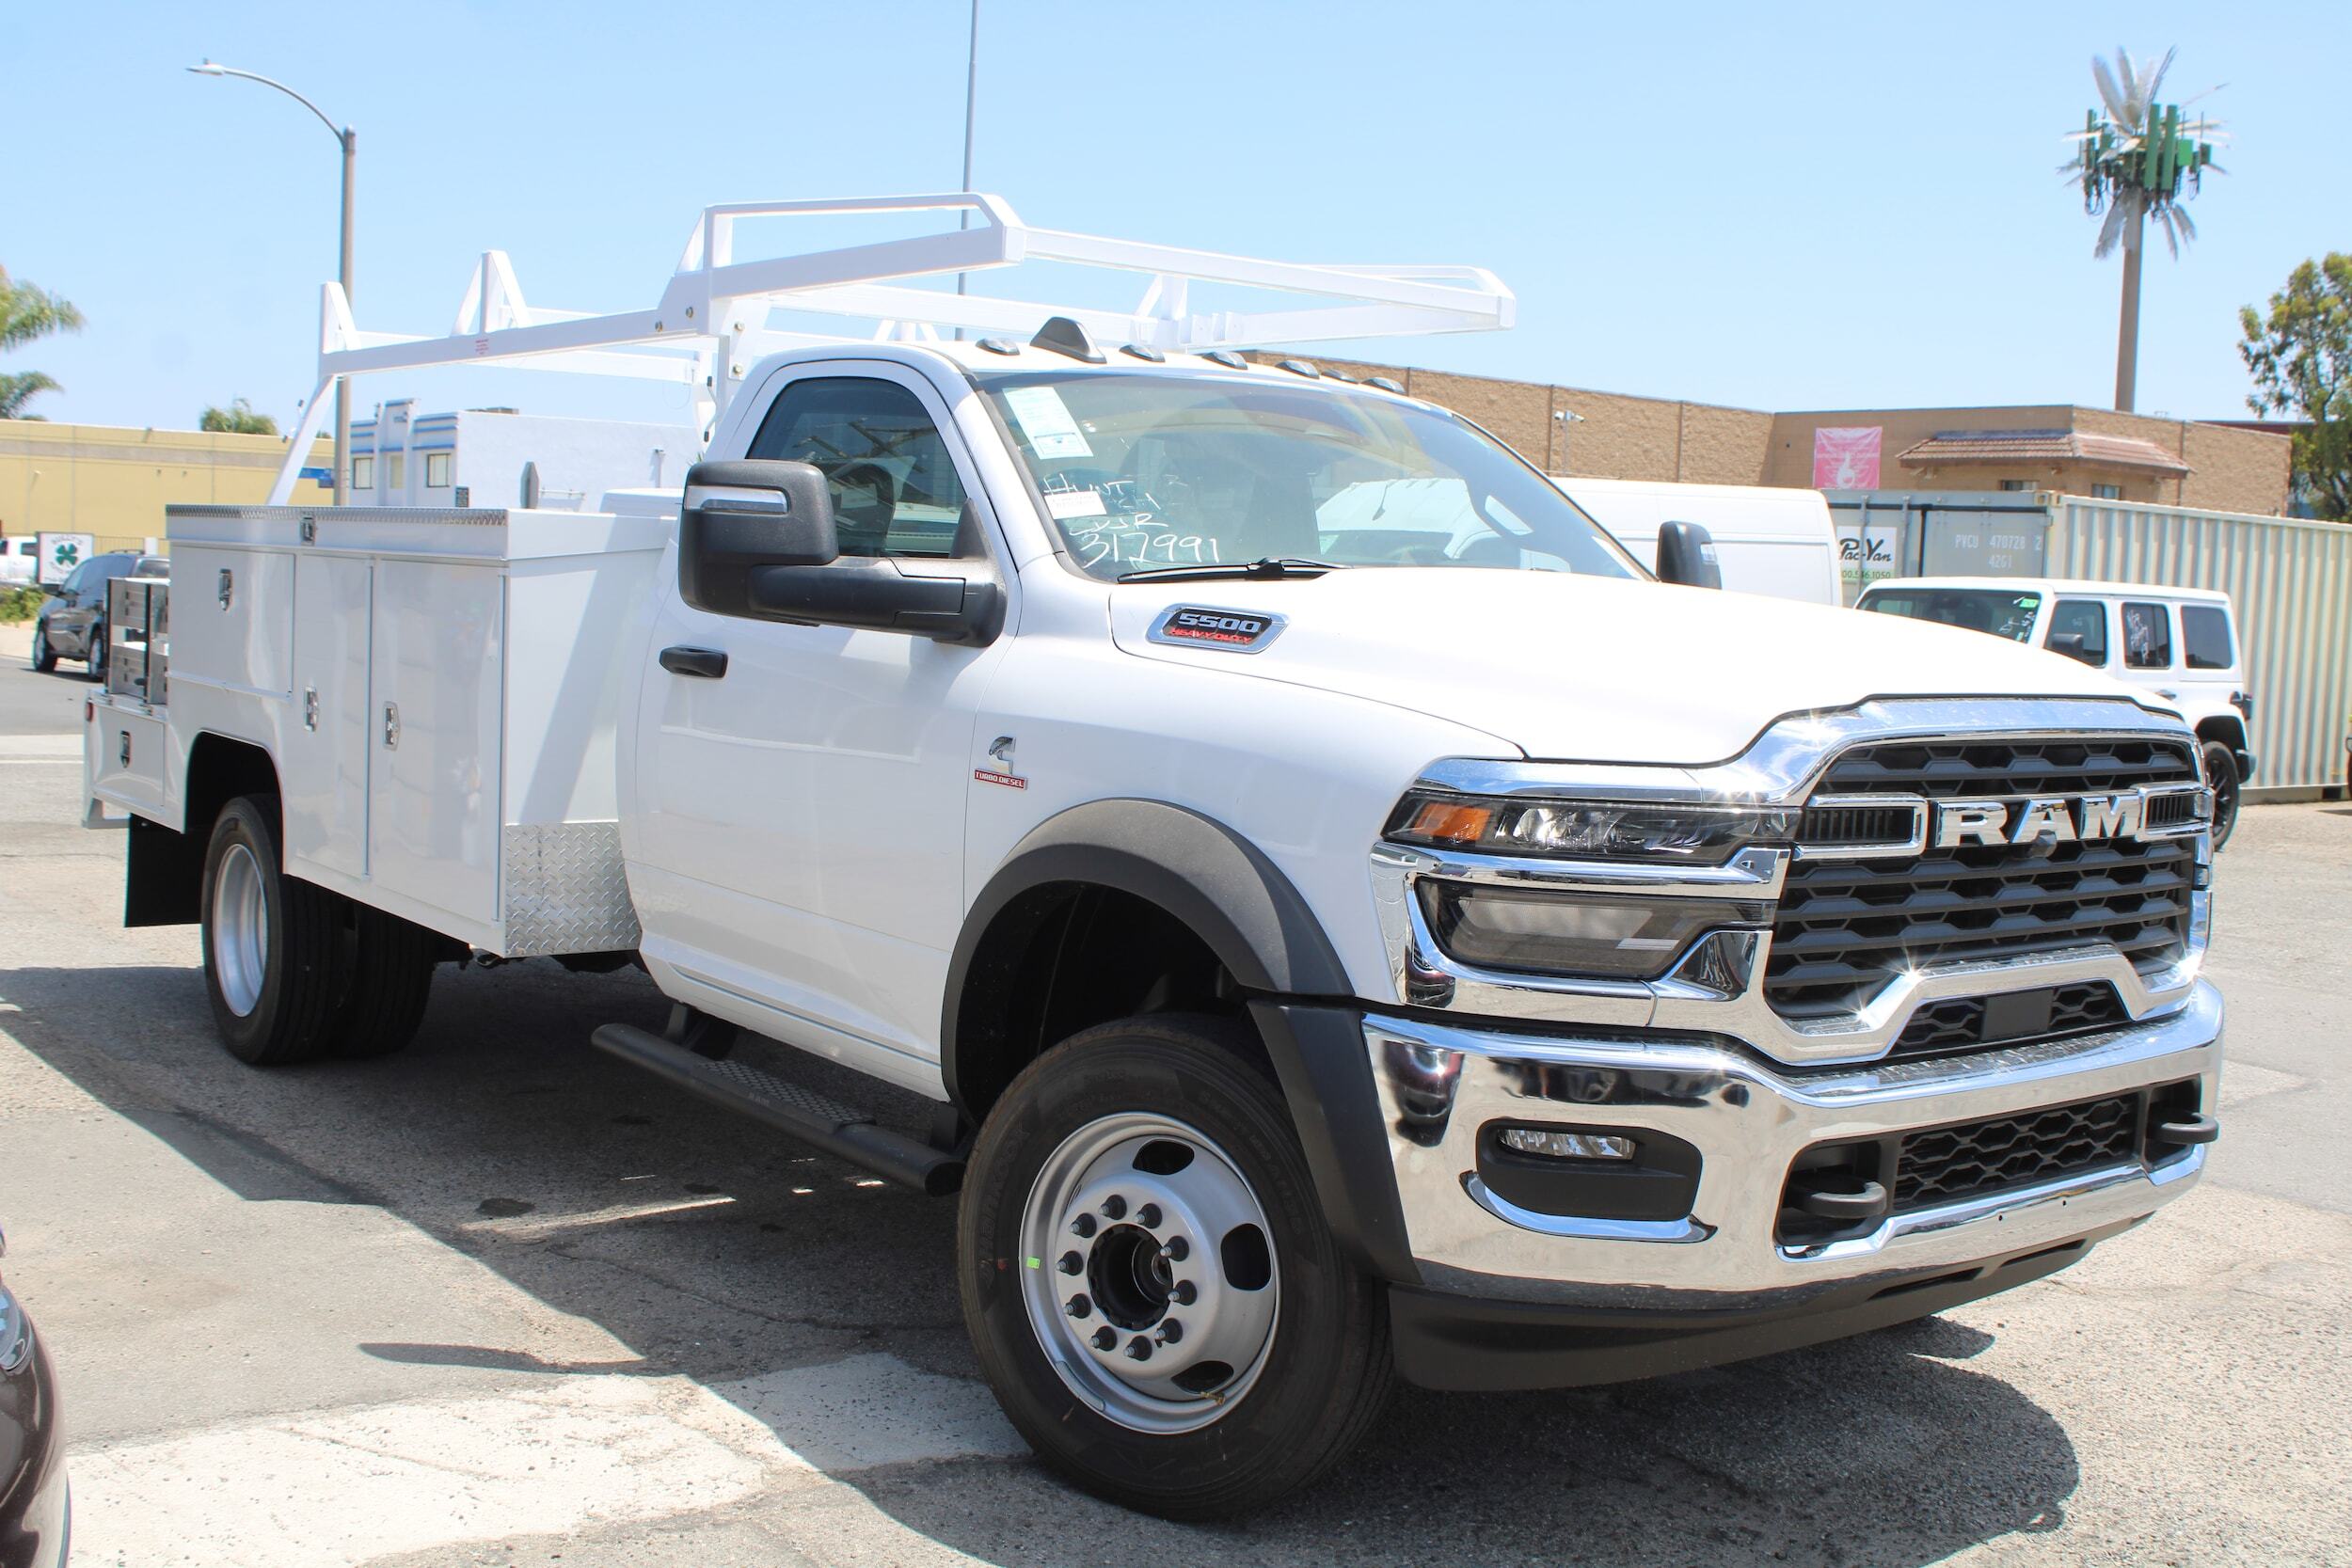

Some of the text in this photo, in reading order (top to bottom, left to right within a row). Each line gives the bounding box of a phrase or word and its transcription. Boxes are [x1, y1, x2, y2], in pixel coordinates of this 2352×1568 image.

[1080, 532, 1220, 569] 317991
[1838, 538, 1892, 562] Pac-Van
[2033, 534, 2042, 551] 2
[1178, 612, 1262, 633] 5500
[1168, 627, 1253, 643] HEAVY DUTY
[976, 771, 1024, 787] TURBO DIESEL
[1935, 794, 2138, 847] RAM
